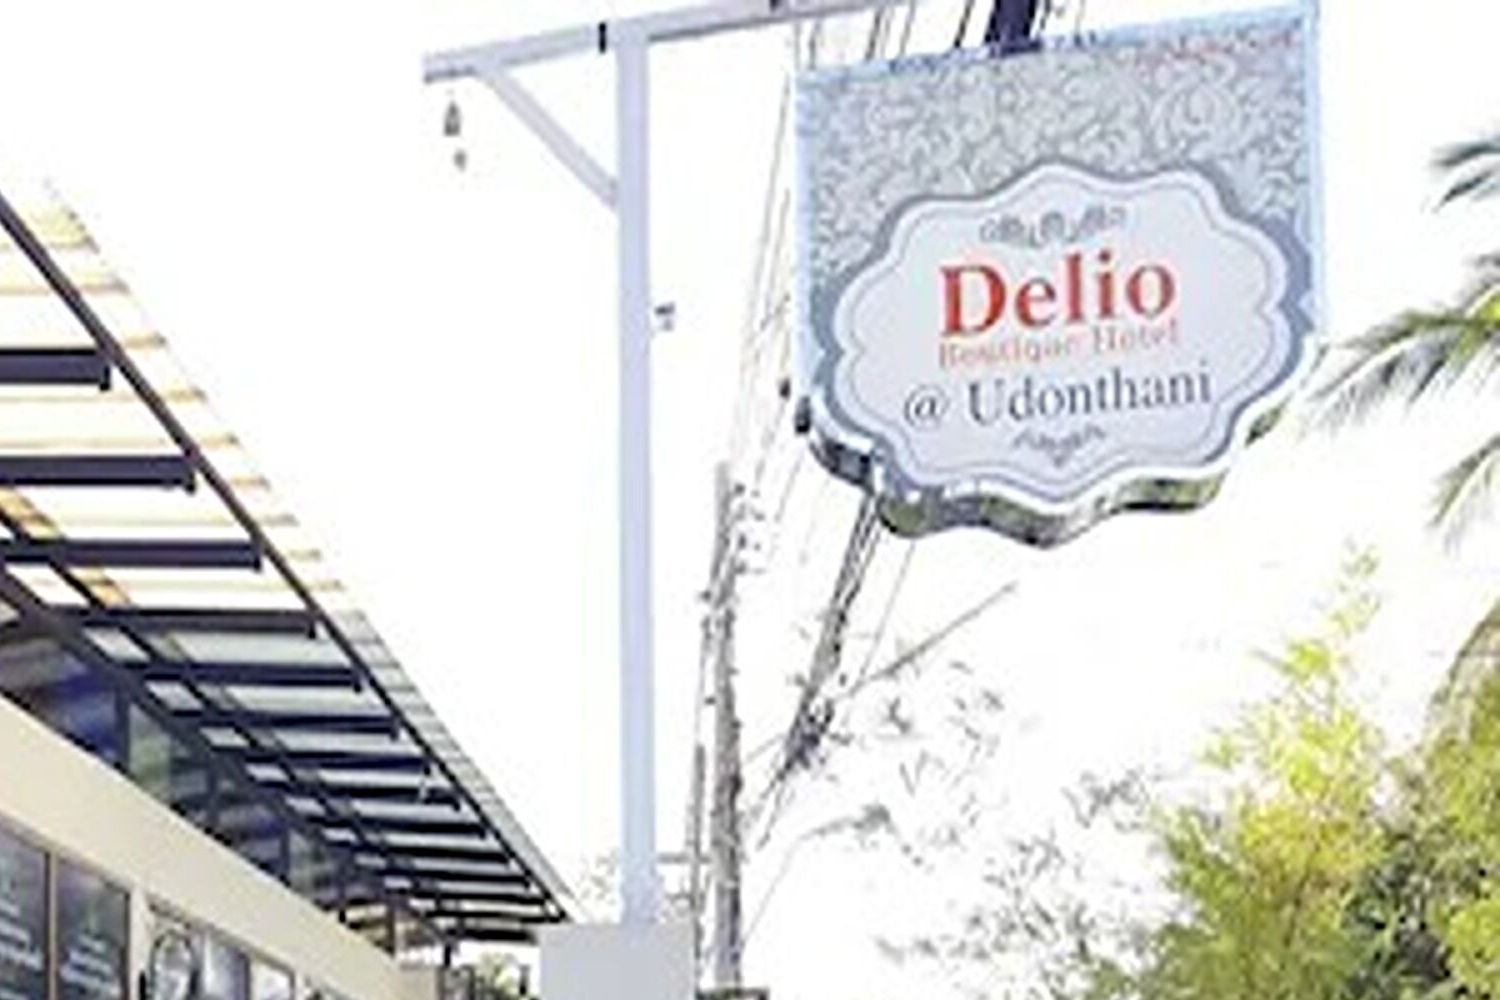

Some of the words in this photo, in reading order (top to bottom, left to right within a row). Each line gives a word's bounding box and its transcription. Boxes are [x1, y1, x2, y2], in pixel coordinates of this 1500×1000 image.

[939, 247, 1177, 338] Delio
[1093, 318, 1178, 356] Hotel
[902, 383, 950, 430] @
[968, 358, 1213, 428] Udonthani
